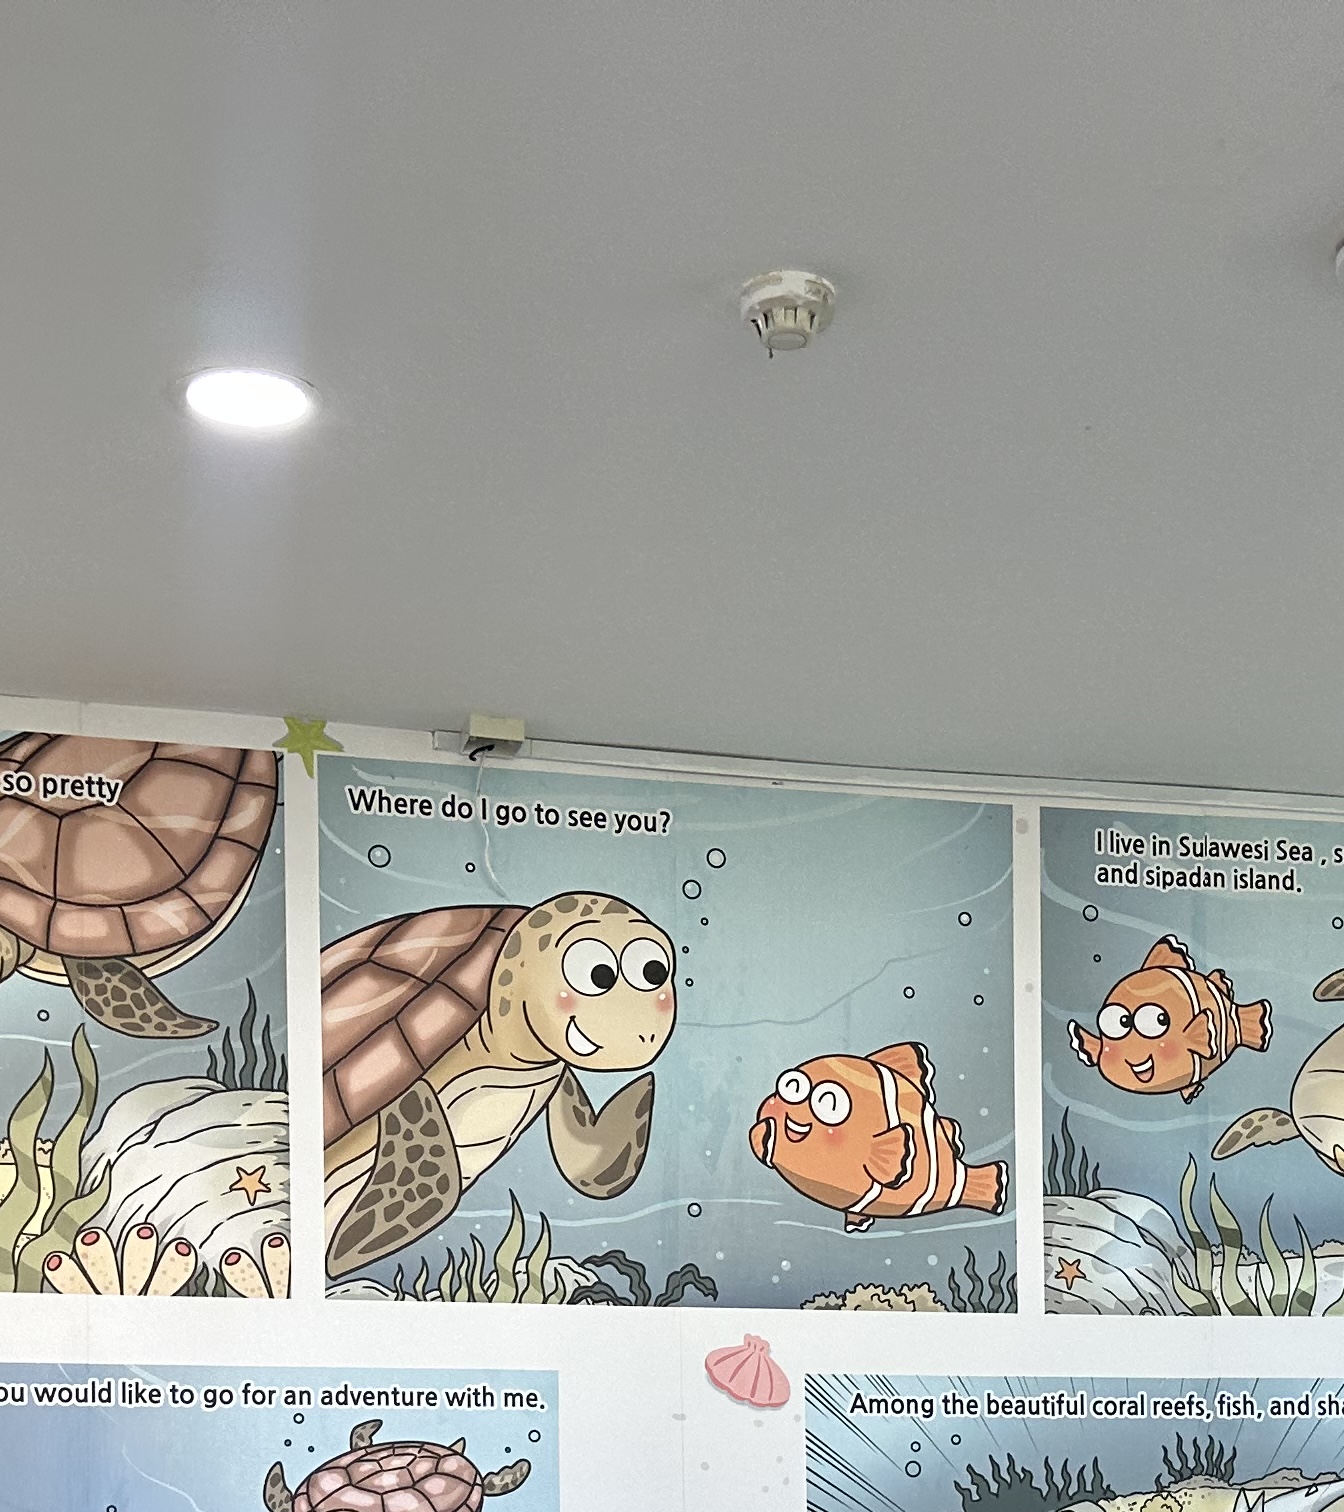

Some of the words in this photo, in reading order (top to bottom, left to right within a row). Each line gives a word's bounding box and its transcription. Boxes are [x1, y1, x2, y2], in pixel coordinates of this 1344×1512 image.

[3, 772, 33, 792] so
[42, 775, 119, 802] pretty
[347, 787, 433, 817] Where
[441, 793, 473, 819] do
[481, 797, 487, 820] I
[495, 804, 527, 826] go
[534, 803, 560, 826] to
[568, 809, 607, 829] see
[614, 811, 671, 834] you?
[1097, 830, 1102, 852] I
[1109, 830, 1145, 855] live
[1152, 834, 1171, 857] in
[1179, 835, 1269, 861] Sulawesi
[1276, 839, 1313, 862] Sea
[1097, 862, 1138, 885] and
[1145, 865, 1225, 890] sipadan
[1233, 867, 1302, 893] island.
[33, 1380, 112, 1404] would
[121, 1381, 162, 1405] like
[169, 1384, 195, 1405] to
[203, 1388, 234, 1409] go
[241, 1382, 277, 1405] for
[284, 1389, 312, 1406] an
[320, 1383, 438, 1407] adventure
[444, 1385, 494, 1408] with
[503, 1392, 545, 1410] me.
[849, 1391, 934, 1419] Among
[941, 1392, 979, 1415] the
[986, 1392, 1085, 1417] beautiful
[1092, 1394, 1145, 1416] coral
[1153, 1394, 1211, 1420] reefs,
[1217, 1393, 1262, 1419] fish,
[1270, 1393, 1310, 1416] and
